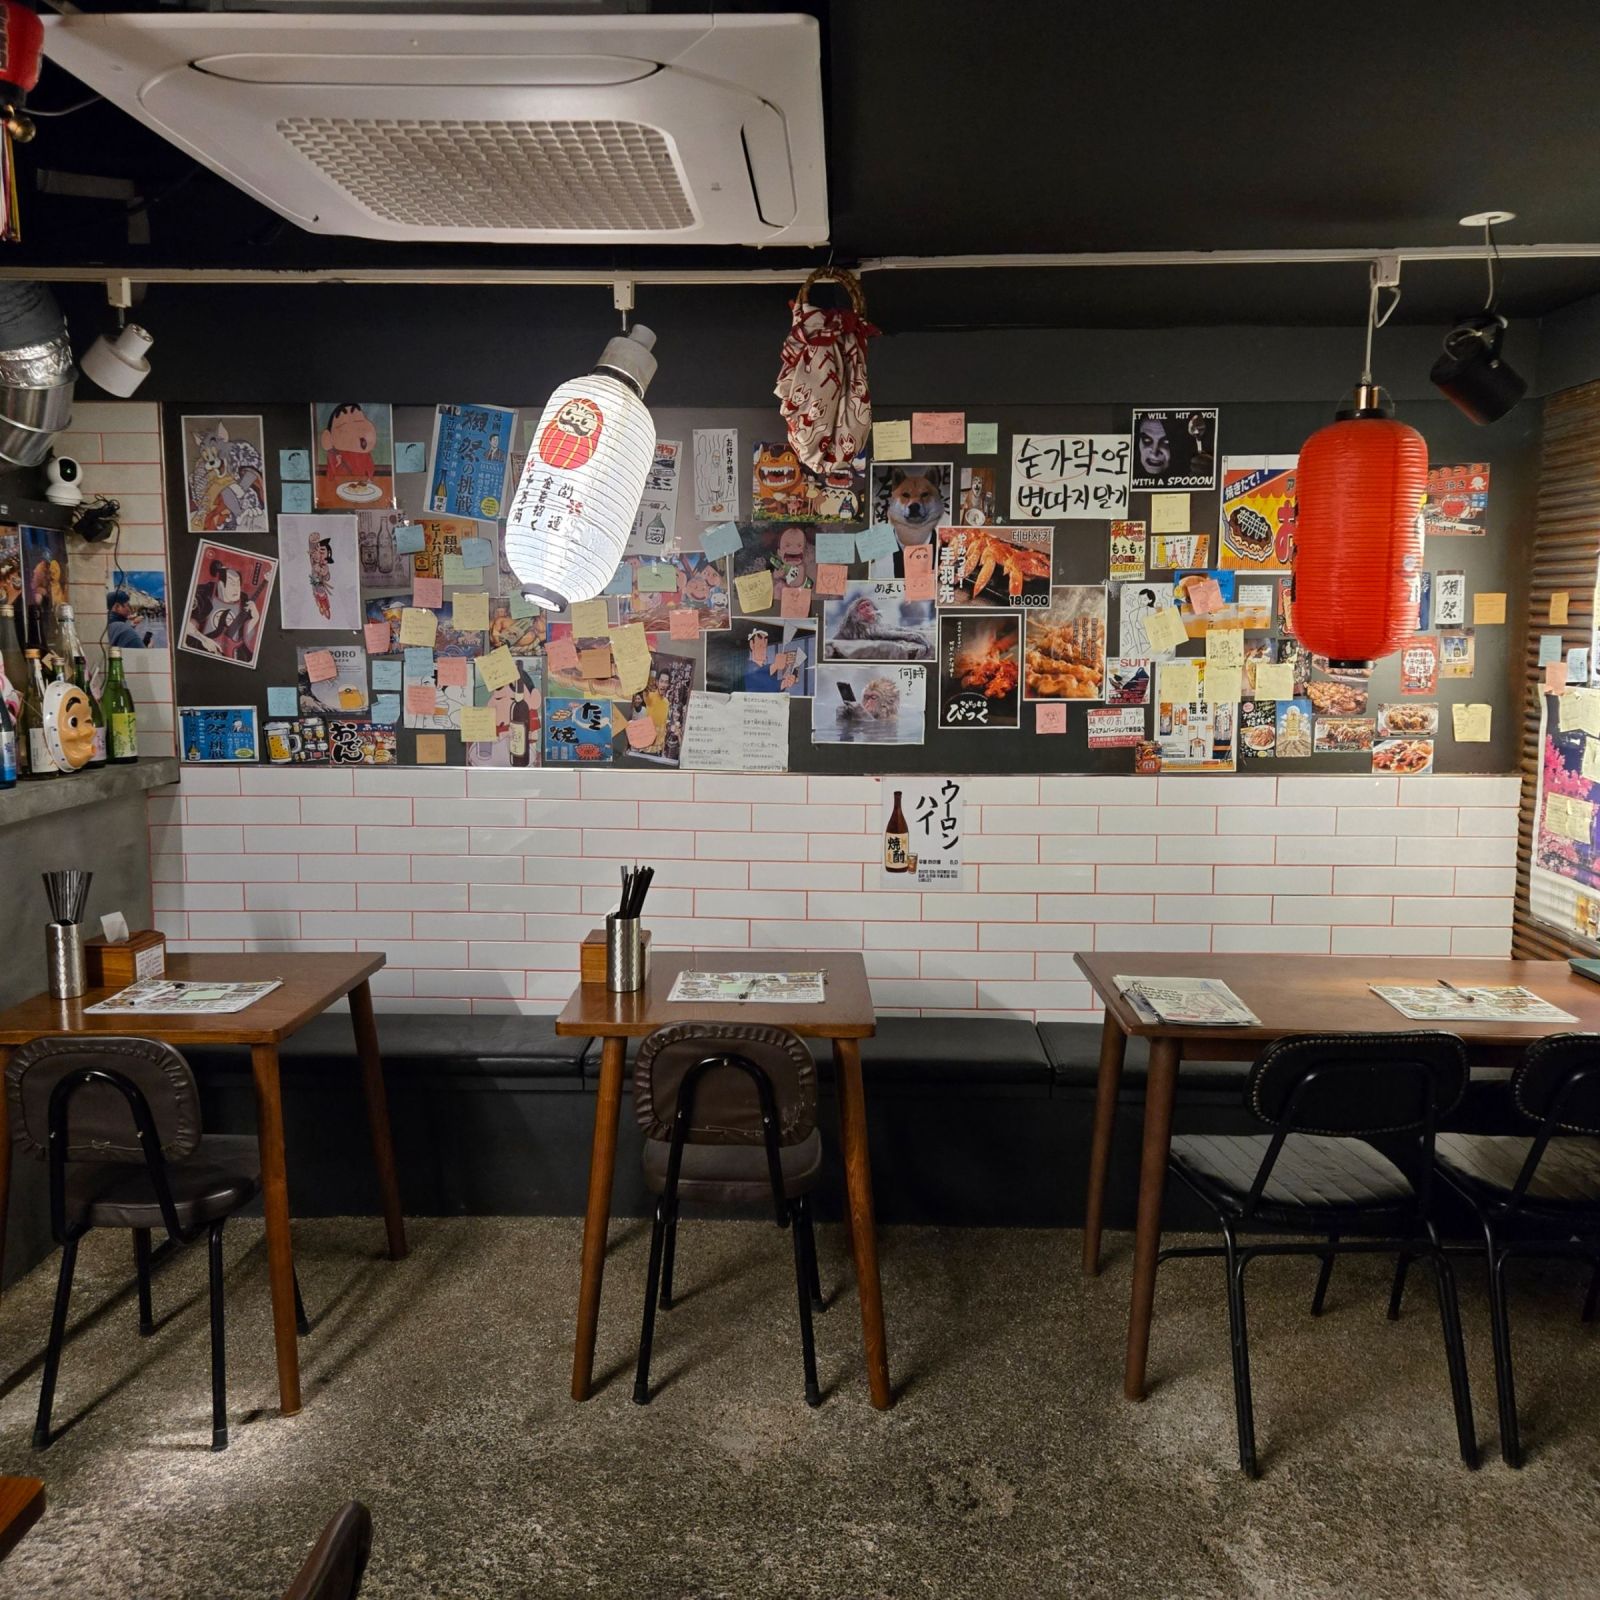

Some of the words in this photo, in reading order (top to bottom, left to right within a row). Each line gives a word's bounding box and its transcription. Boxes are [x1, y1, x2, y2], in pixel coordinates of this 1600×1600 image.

[1133, 412, 1143, 420] IT
[1147, 412, 1168, 420] WILL
[1175, 412, 1191, 420] HIT
[725, 437, 735, 485] お好み焼き
[1132, 478, 1155, 486] WITH
[1157, 478, 1165, 486] A
[1011, 530, 1051, 544] 테바사키
[1112, 542, 1144, 555] もちもち
[939, 546, 955, 604] 手羽先
[1009, 595, 1049, 606] 18.000
[1119, 657, 1150, 668] SUIT
[898, 666, 925, 681] 何時
[946, 703, 990, 725] びっく
[329, 721, 365, 764] おでん
[915, 795, 939, 836] ハイ
[940, 779, 961, 851] ウーロン
[887, 836, 906, 864] 焼酎
